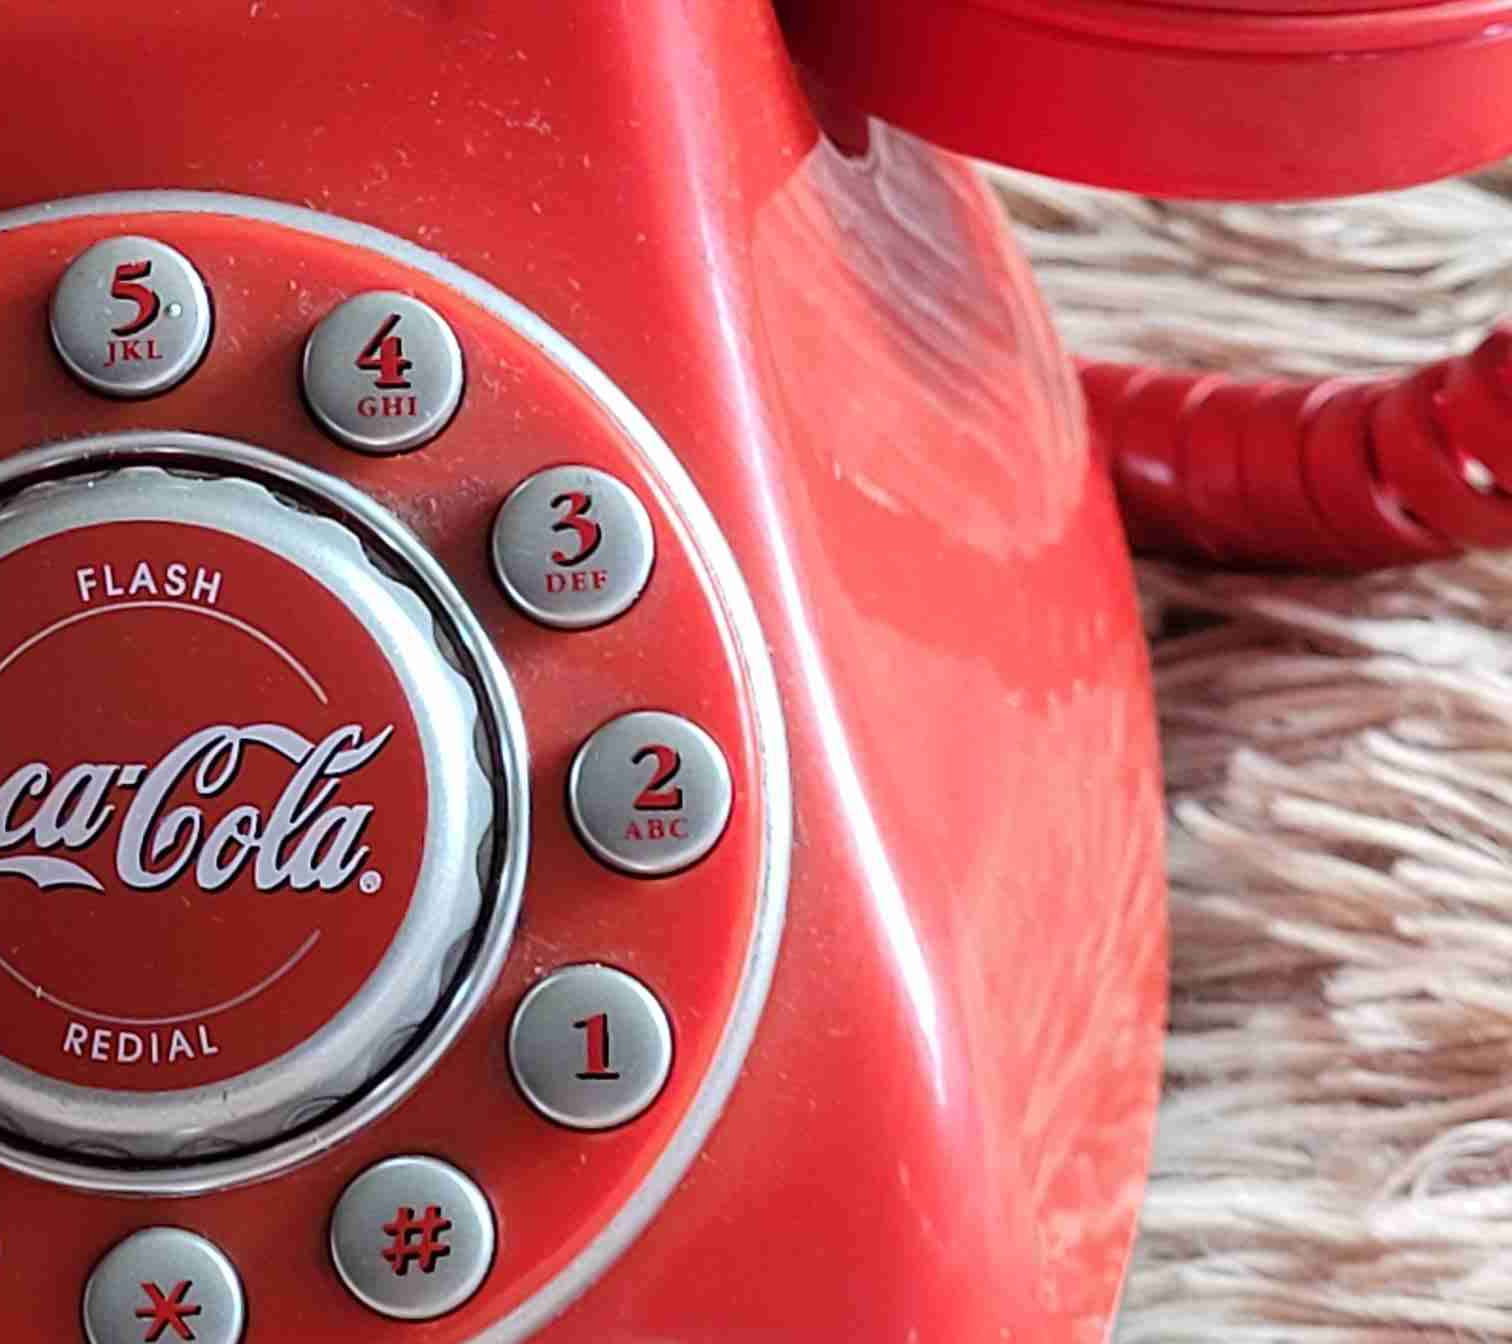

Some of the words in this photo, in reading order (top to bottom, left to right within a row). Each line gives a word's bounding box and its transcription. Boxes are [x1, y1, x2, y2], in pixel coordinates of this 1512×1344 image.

[110, 260, 161, 336] 5
[104, 339, 163, 367] JKL
[355, 312, 413, 389] 4
[357, 395, 417, 417] GHI
[550, 490, 601, 566] 3
[76, 562, 223, 605] FLASH
[545, 570, 608, 594] DEF
[631, 743, 683, 811] 2
[623, 817, 689, 841] ABC
[63, 1021, 218, 1064] REDIAL
[574, 1013, 619, 1080] 1
[382, 1203, 452, 1276] #
